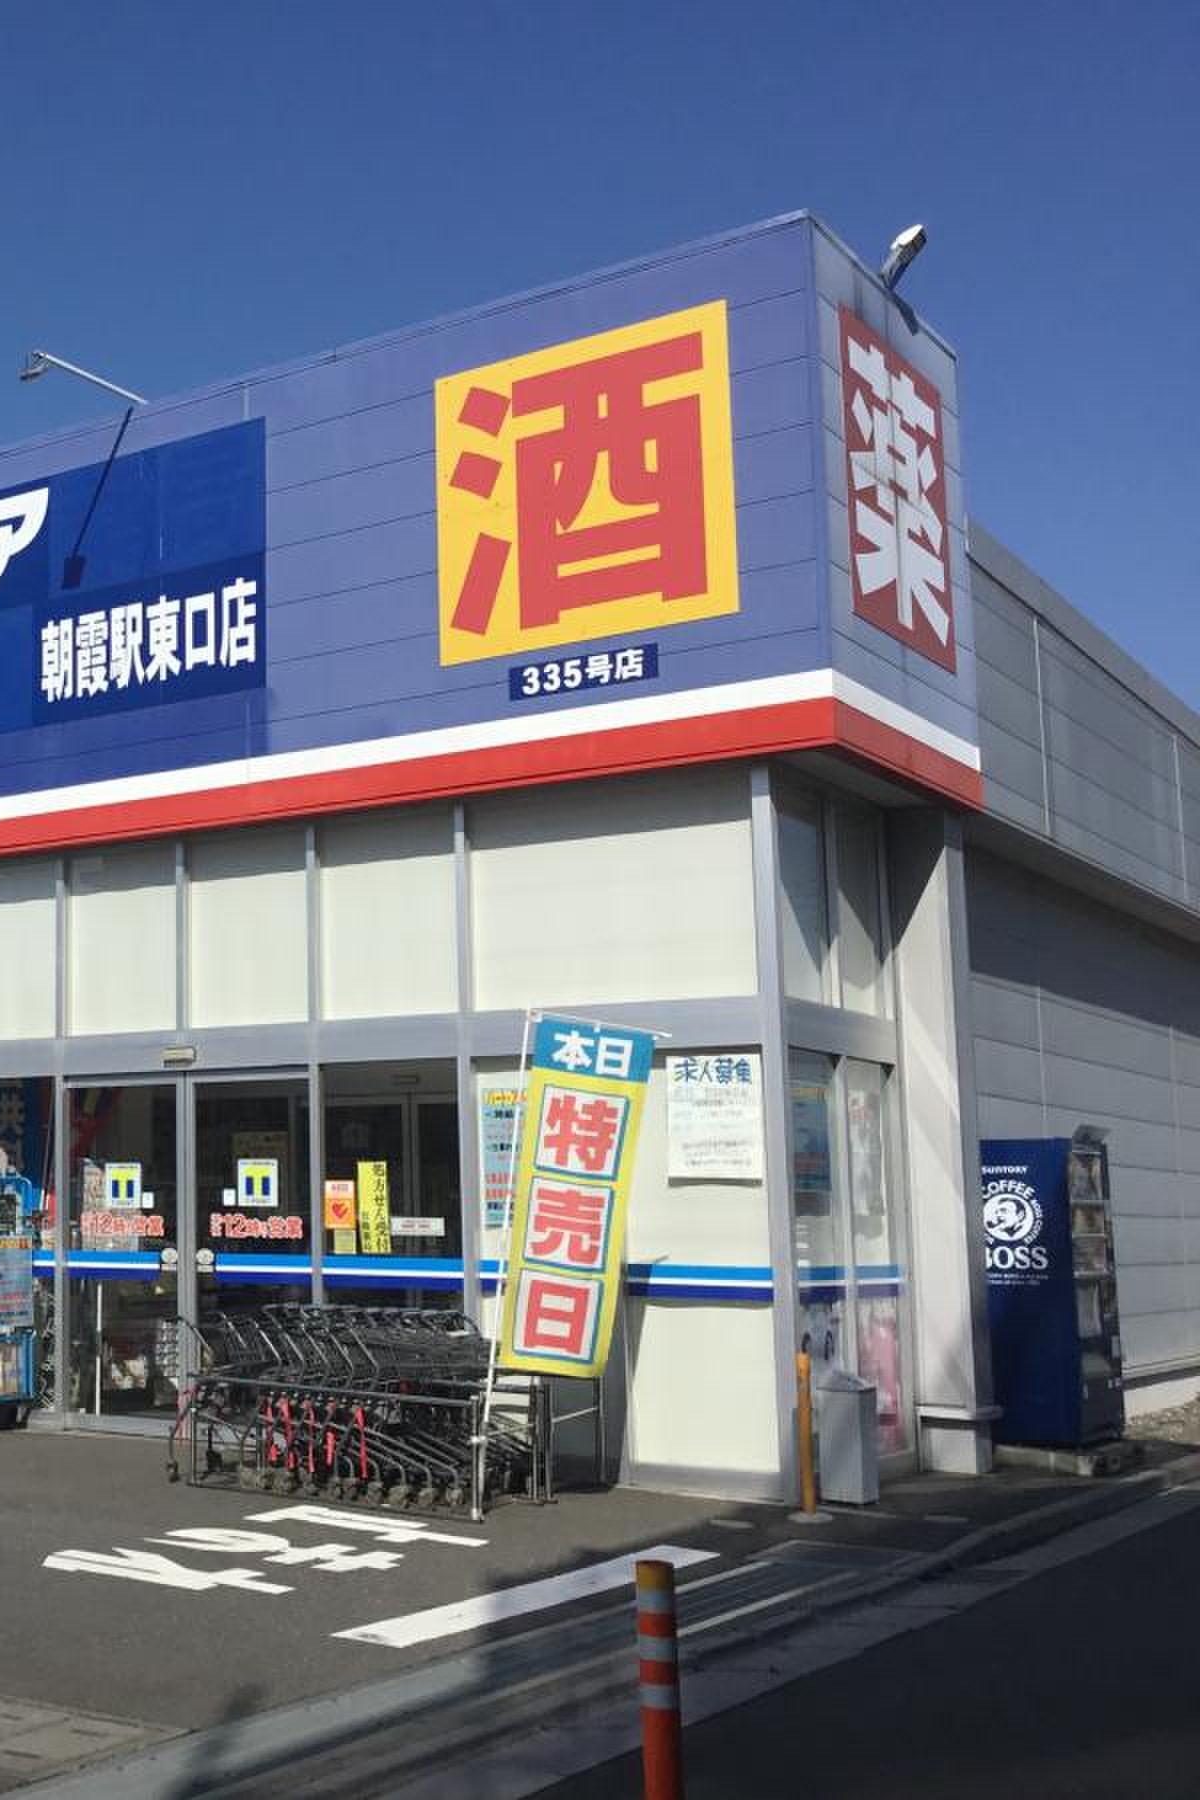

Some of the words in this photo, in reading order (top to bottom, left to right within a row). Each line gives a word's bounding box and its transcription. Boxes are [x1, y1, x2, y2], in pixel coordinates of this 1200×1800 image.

[449, 331, 708, 635] 酒
[846, 335, 950, 646] 薬
[40, 577, 256, 703] 朝霞駅東口店
[521, 648, 644, 696] 335号店
[553, 1030, 633, 1079] 本日
[673, 1056, 753, 1085] 求人募集
[523, 1094, 619, 1355] 特売日
